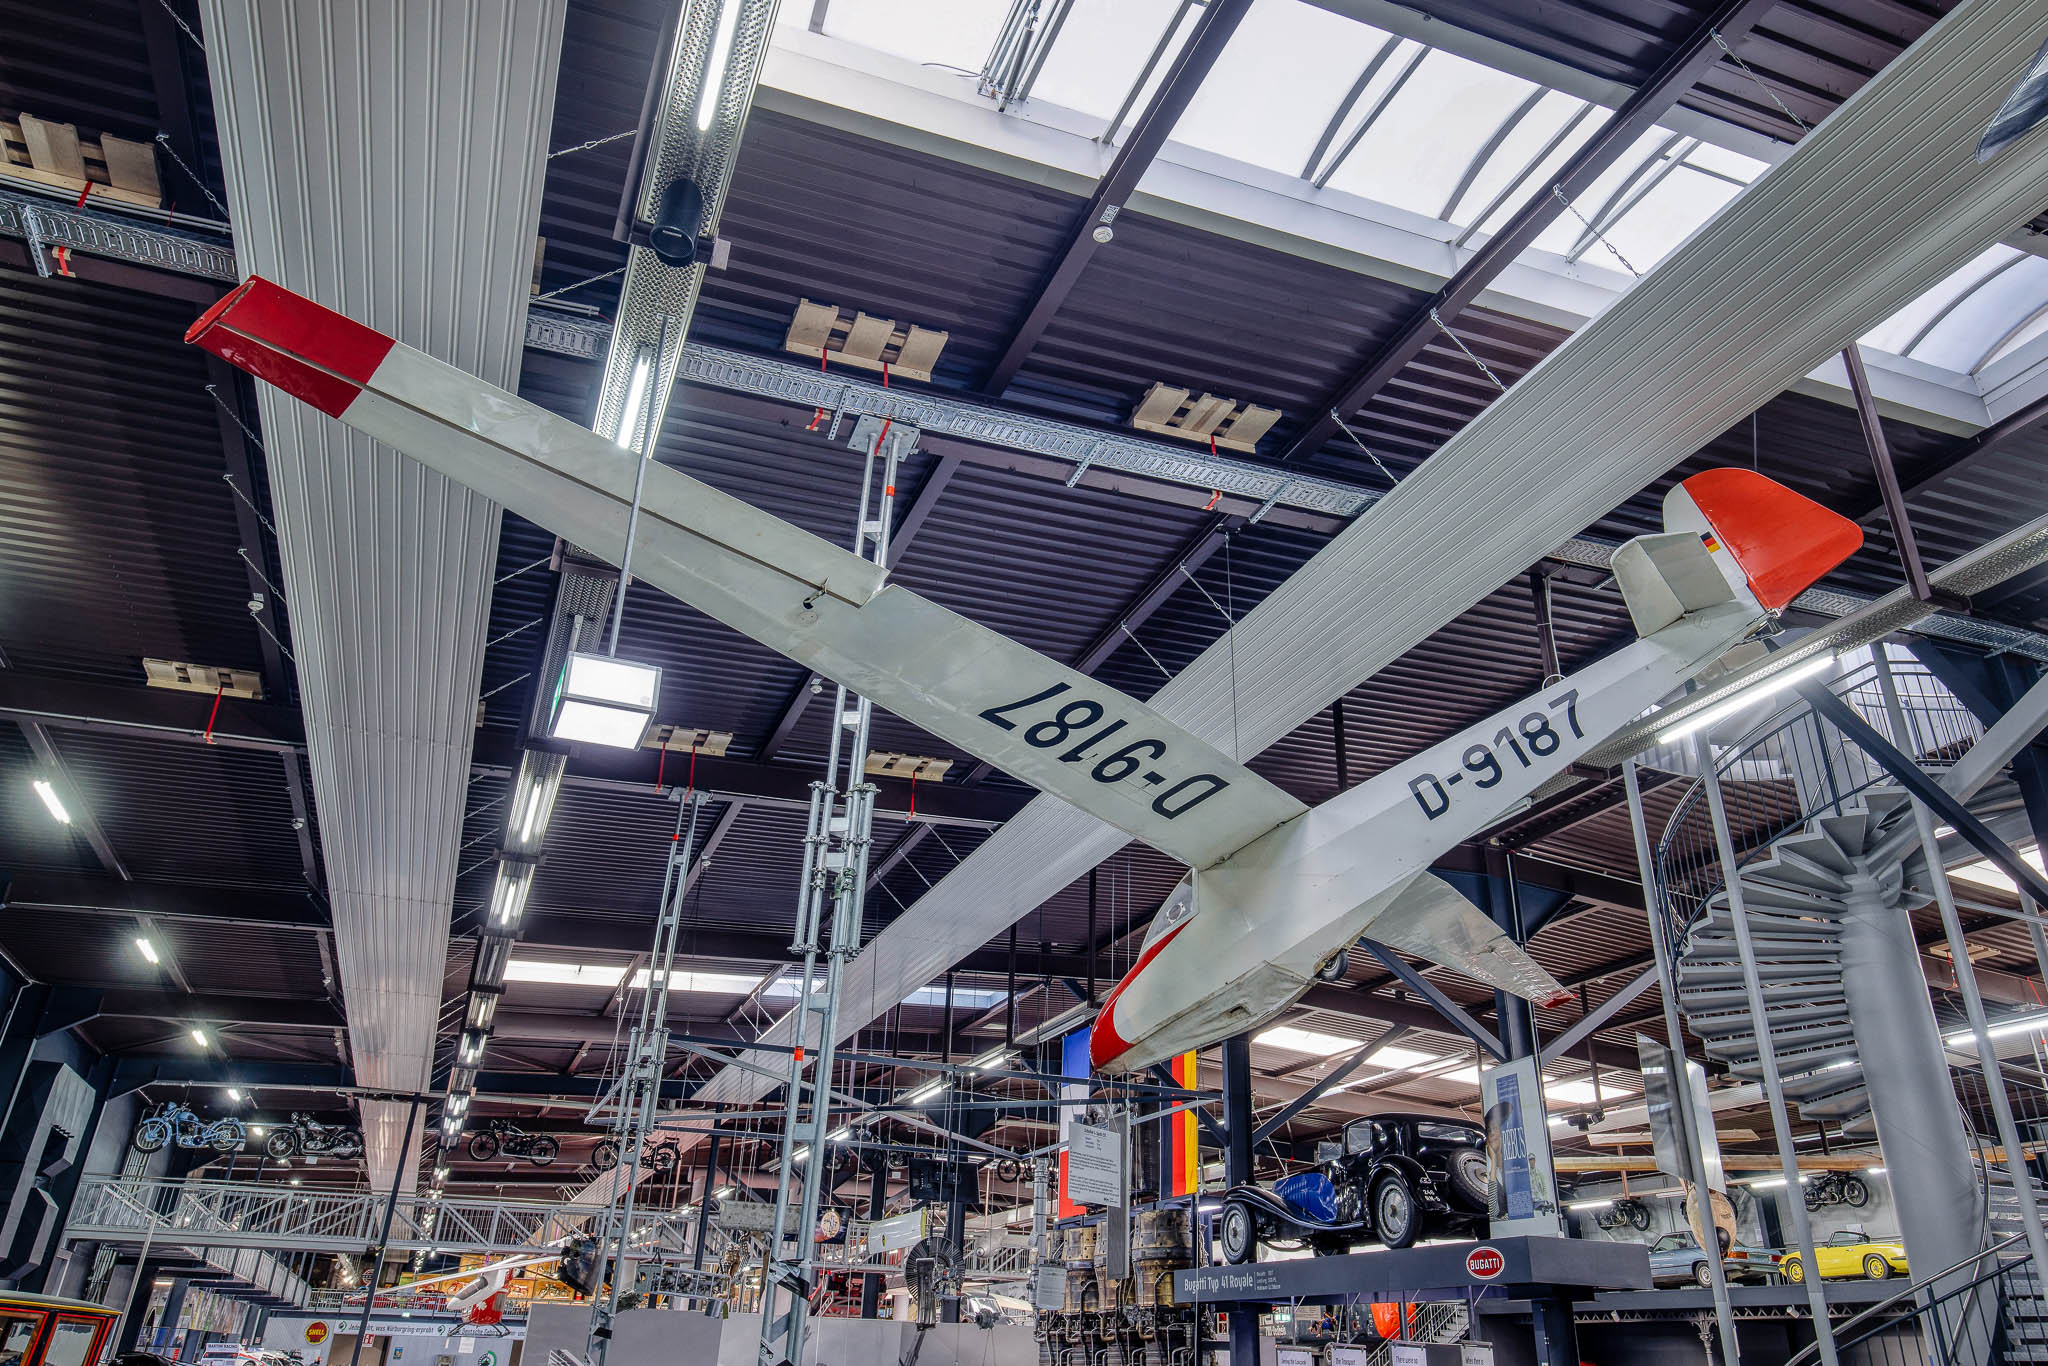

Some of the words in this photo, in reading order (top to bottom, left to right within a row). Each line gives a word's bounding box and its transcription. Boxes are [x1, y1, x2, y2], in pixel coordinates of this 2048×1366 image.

[978, 682, 1231, 820] D-9187
[1407, 688, 1585, 821] D-9187
[1469, 1257, 1500, 1270] BUGATTI
[1184, 1276, 1207, 1295] Bugatti
[1207, 1276, 1219, 1293] Typ
[1221, 1275, 1229, 1289] 41
[1229, 1272, 1253, 1291] Royale
[308, 1328, 326, 1336] SHELL
